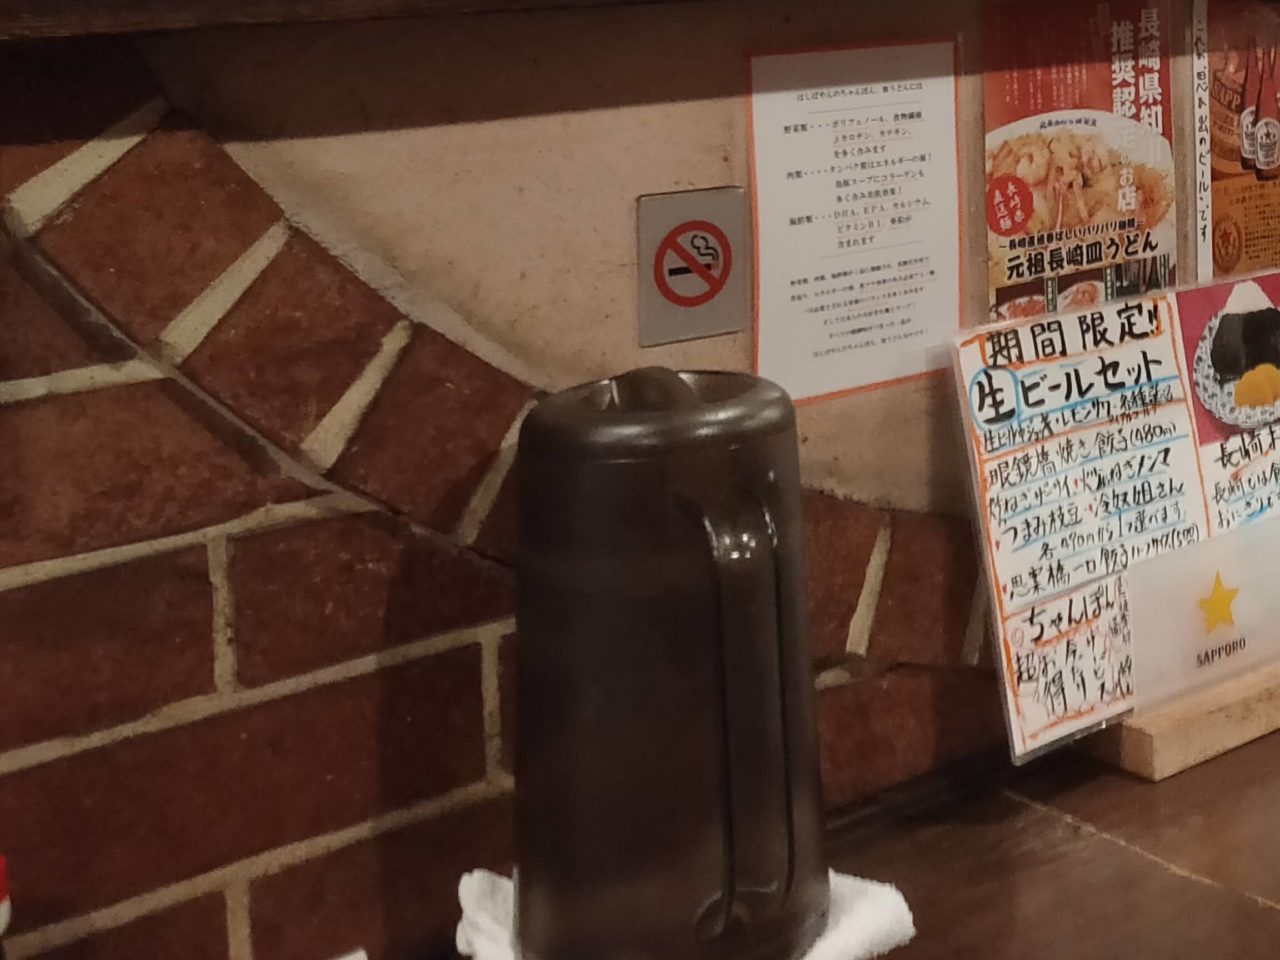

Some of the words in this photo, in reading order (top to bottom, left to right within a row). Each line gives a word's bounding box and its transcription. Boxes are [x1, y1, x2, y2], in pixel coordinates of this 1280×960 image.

[1006, 232, 1159, 280] 元祖長崎皿うどん
[976, 350, 1162, 424] 生ビールセット
[1196, 637, 1247, 669] SAPPORO
